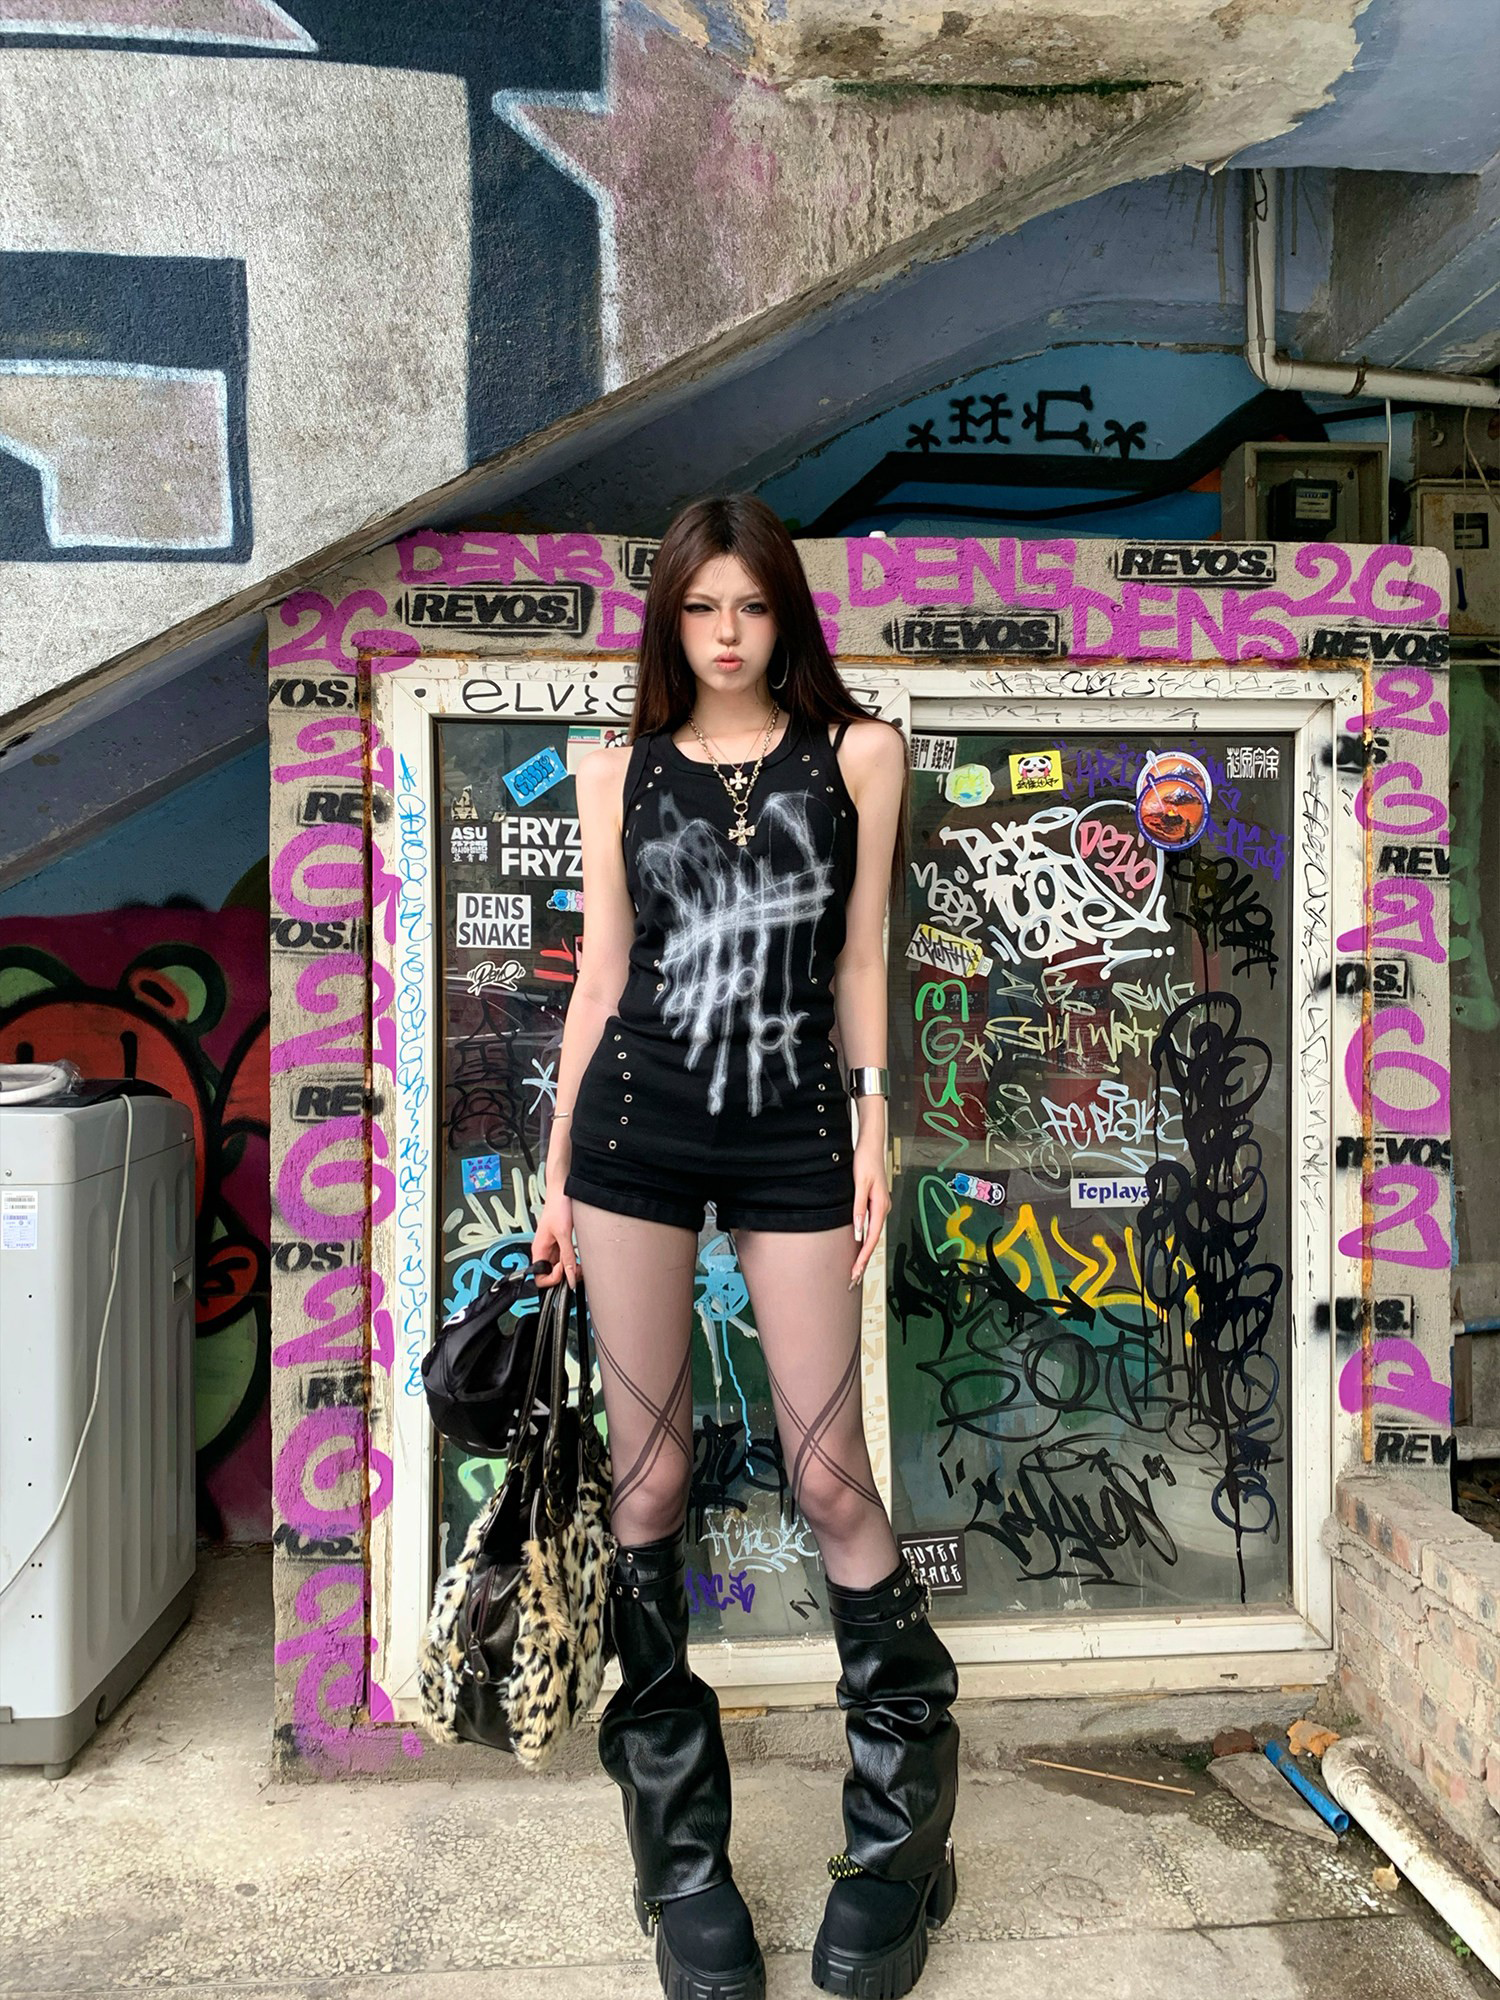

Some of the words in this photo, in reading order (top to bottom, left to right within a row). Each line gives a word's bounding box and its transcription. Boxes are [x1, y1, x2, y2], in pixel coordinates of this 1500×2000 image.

[846, 537, 1076, 611] DENS
[451, 826, 487, 840] ASU
[465, 895, 524, 920] DENS
[458, 922, 530, 947] SNAKE
